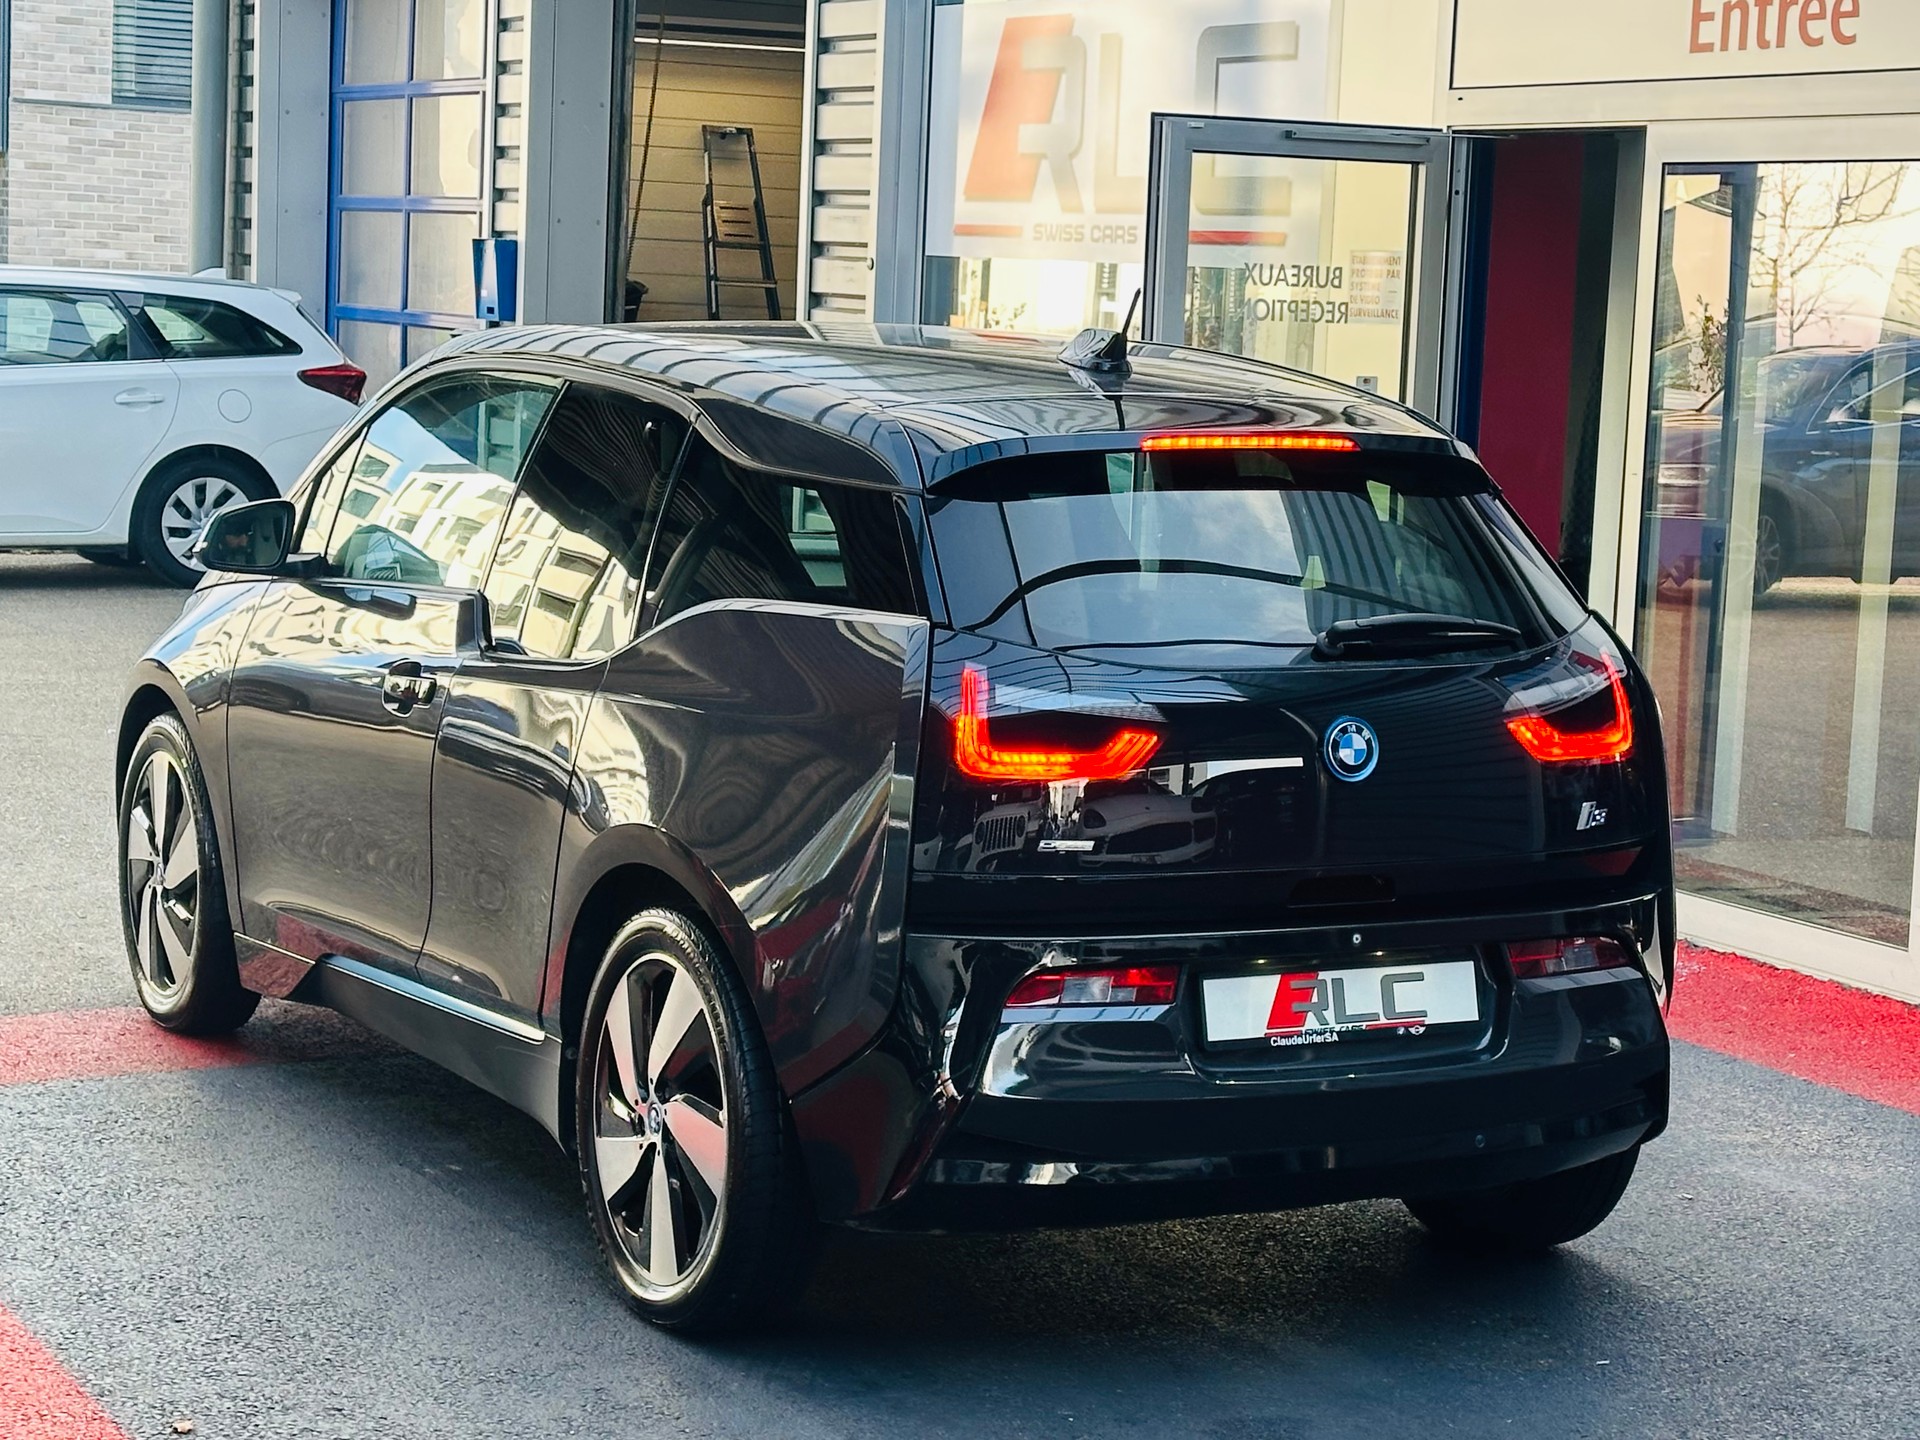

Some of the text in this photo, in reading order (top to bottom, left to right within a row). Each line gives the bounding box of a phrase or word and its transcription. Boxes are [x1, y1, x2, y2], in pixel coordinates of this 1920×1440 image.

[1033, 223, 1138, 244] SWISS CARS
[1386, 269, 1401, 279] PAR
[1349, 307, 1399, 319] SURVEILLANCE
